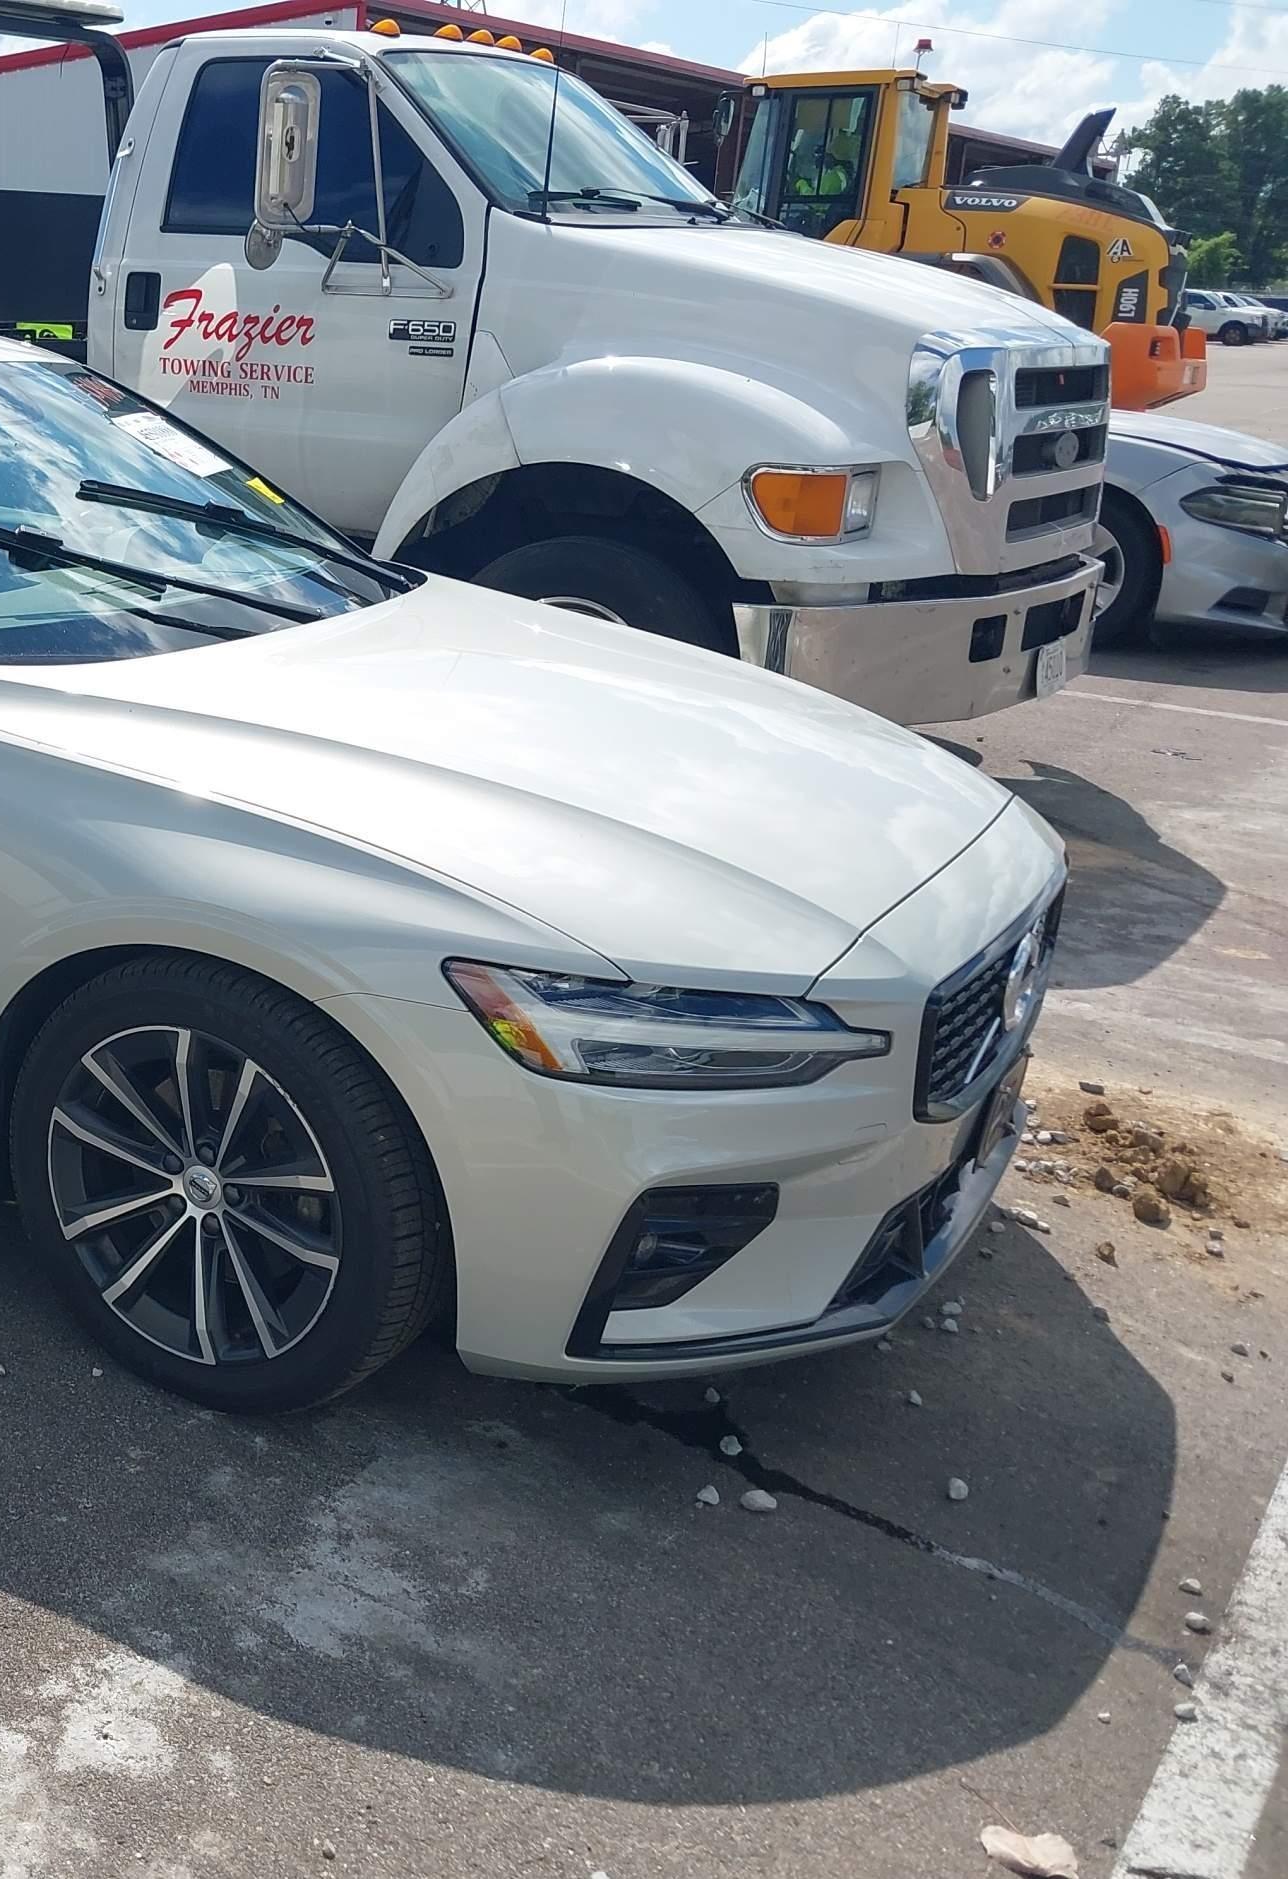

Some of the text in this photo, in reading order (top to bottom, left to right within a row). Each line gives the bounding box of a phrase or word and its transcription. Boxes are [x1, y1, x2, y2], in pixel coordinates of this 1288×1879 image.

[953, 196, 1018, 207] VOLVO
[1117, 288, 1140, 318] L90H
[162, 288, 316, 362] Frazier
[159, 357, 315, 384] TOWING SERVICE
[189, 380, 280, 400] MEMPHIS, TN
